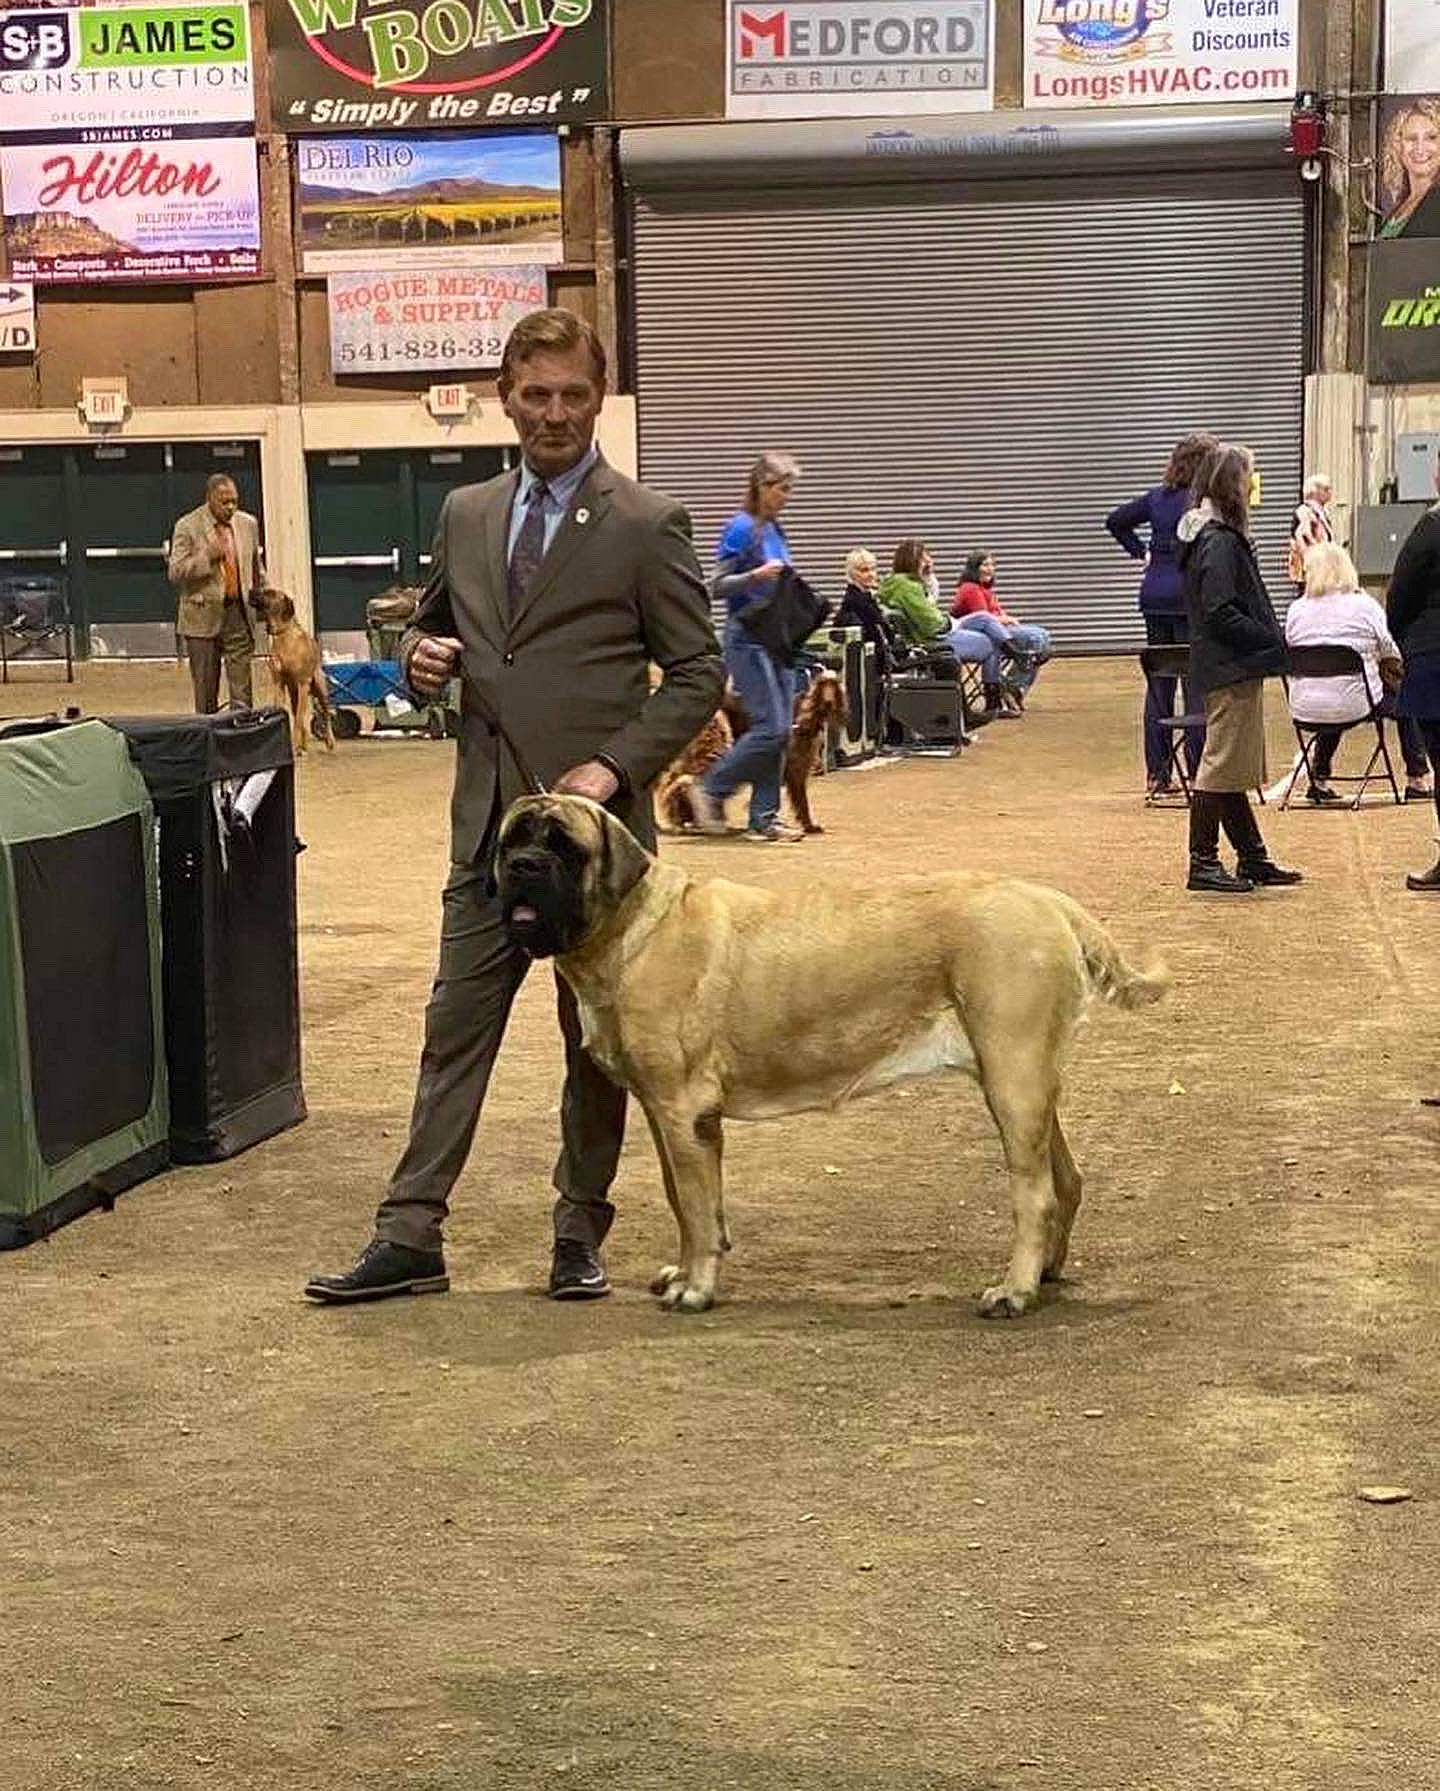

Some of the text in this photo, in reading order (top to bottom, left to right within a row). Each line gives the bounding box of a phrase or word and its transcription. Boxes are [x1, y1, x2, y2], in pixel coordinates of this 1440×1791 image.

[1204, 0, 1279, 18] Veteran
[91, 18, 235, 54] JAMES
[362, 0, 591, 88] BOATS
[740, 10, 975, 59] MEDFORD
[1193, 28, 1290, 51] Discounts
[0, 67, 248, 94] CONSTRUCTION
[741, 67, 977, 88] FABRICATION
[1034, 66, 1289, 99] LongsHVAC.com
[428, 94, 479, 118] the
[81, 126, 173, 142] SBJAMES.COM
[307, 144, 413, 170] DEL RIO
[38, 147, 221, 206] Hilton
[335, 277, 543, 312] ROGUE METALS
[374, 301, 503, 324] & SUPPLY
[341, 337, 501, 361] 541-826-32
[93, 395, 115, 413] EXIT
[437, 388, 460, 406] EXIT
